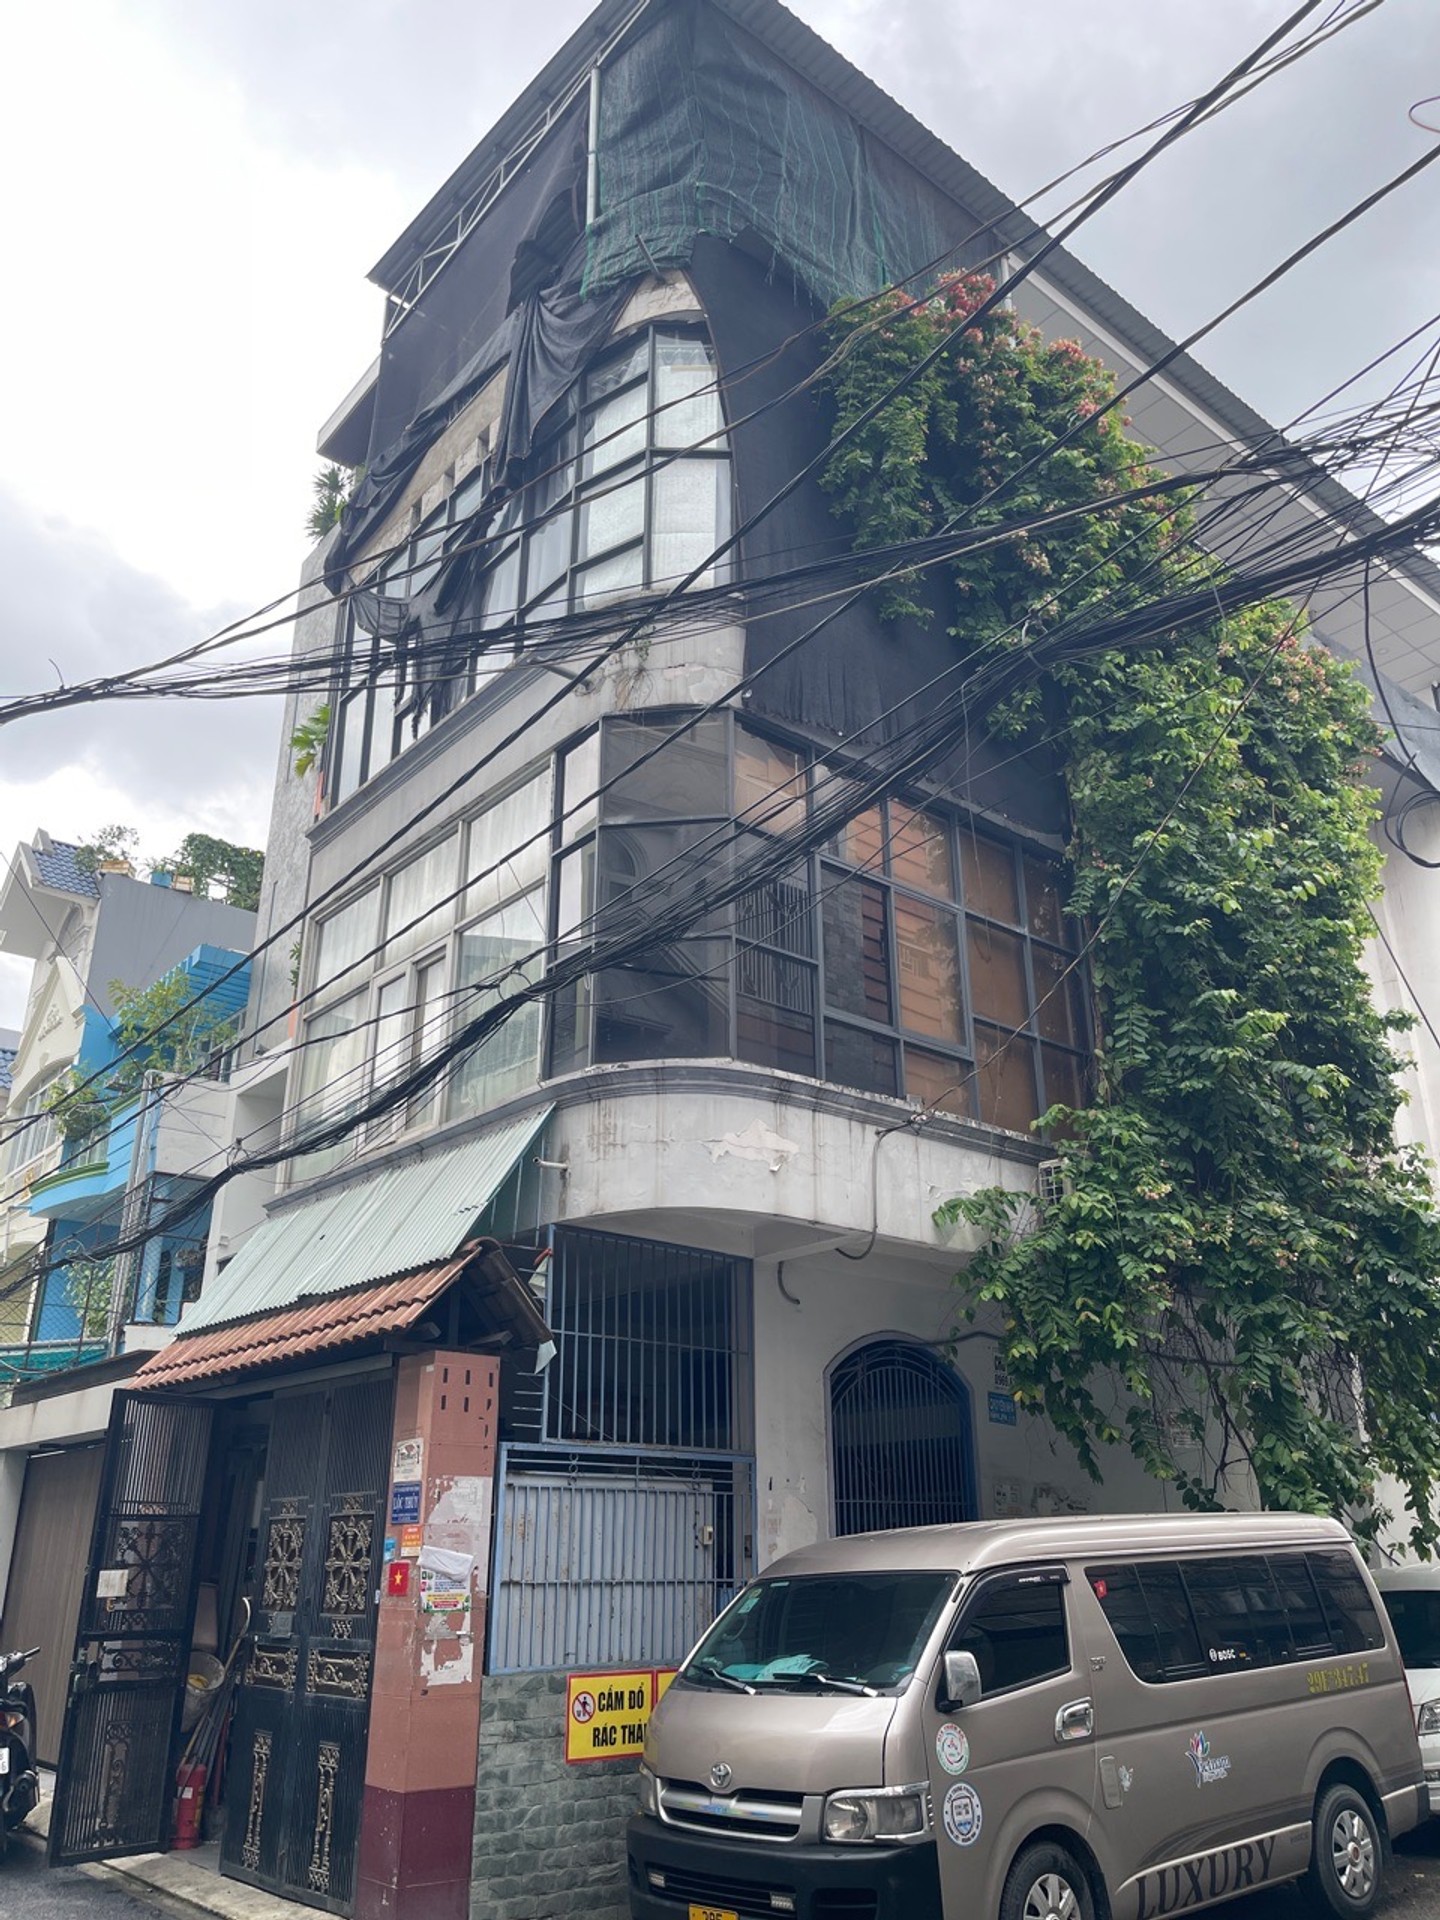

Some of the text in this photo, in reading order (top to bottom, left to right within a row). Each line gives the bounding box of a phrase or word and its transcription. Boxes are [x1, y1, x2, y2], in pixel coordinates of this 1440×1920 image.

[598, 1682, 645, 1712] CẤM ĐỔ
[592, 1723, 617, 1747] RÁC
[1136, 1836, 1276, 1920] LUXURY
